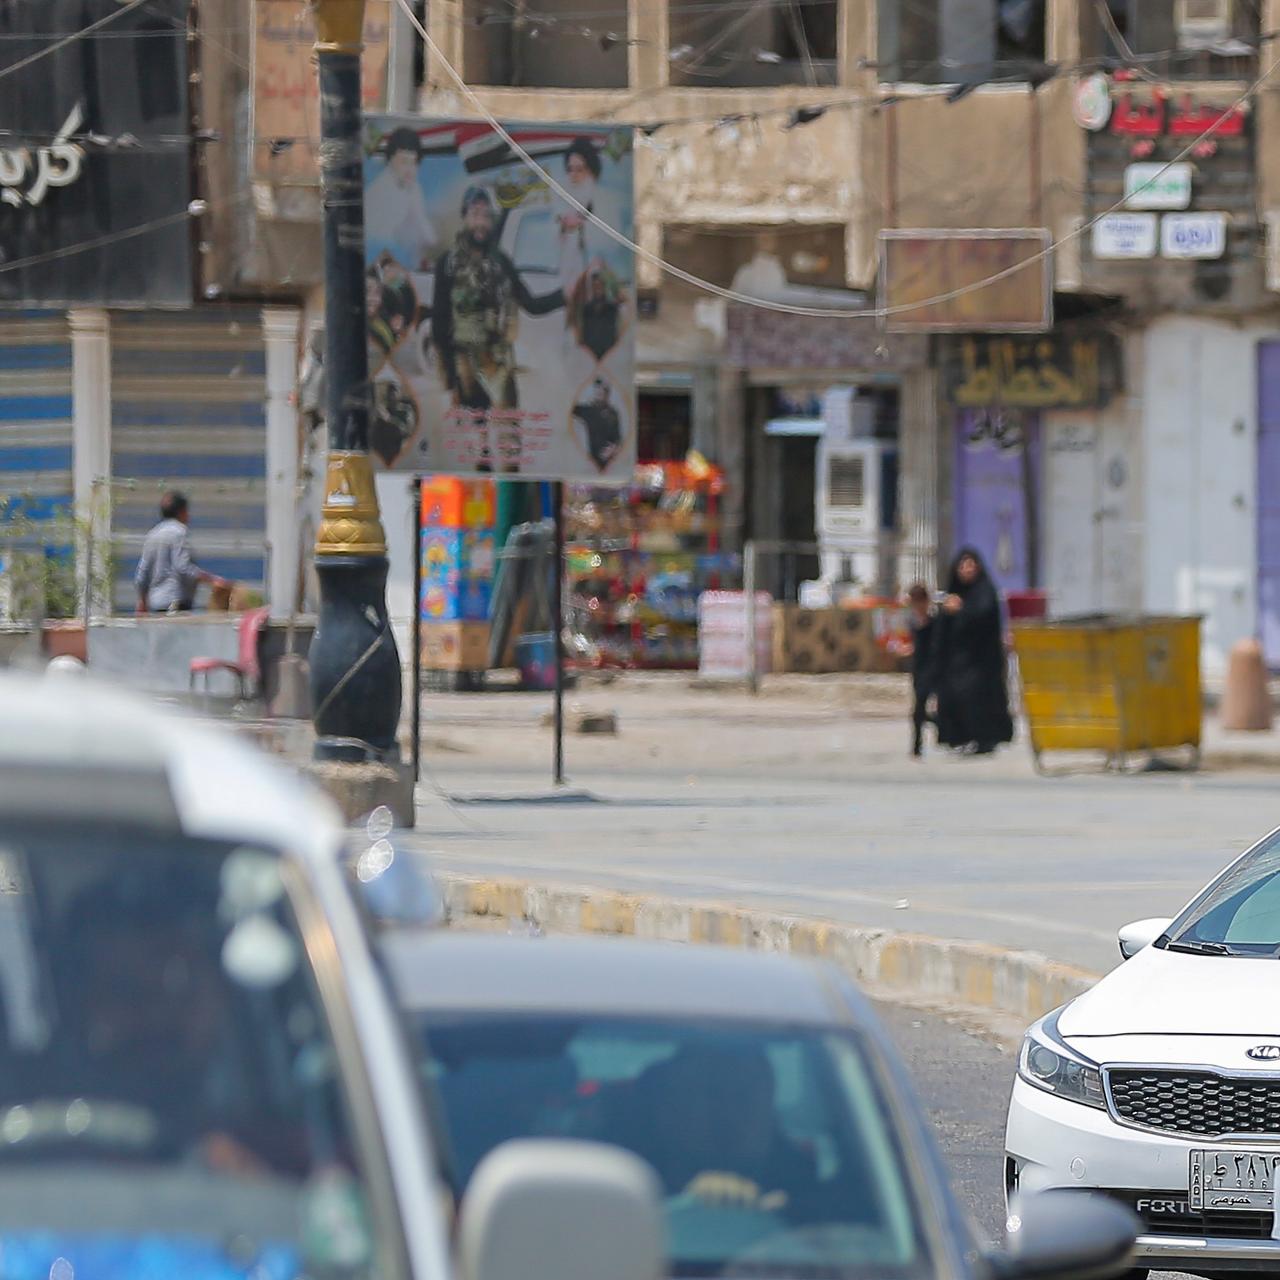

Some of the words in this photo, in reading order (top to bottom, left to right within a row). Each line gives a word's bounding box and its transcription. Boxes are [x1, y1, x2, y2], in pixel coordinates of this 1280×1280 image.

[1251, 1046, 1280, 1057] KIA
[1193, 1153, 1201, 1196] IRAQ
[1210, 1195, 1252, 1206] خصوصي
